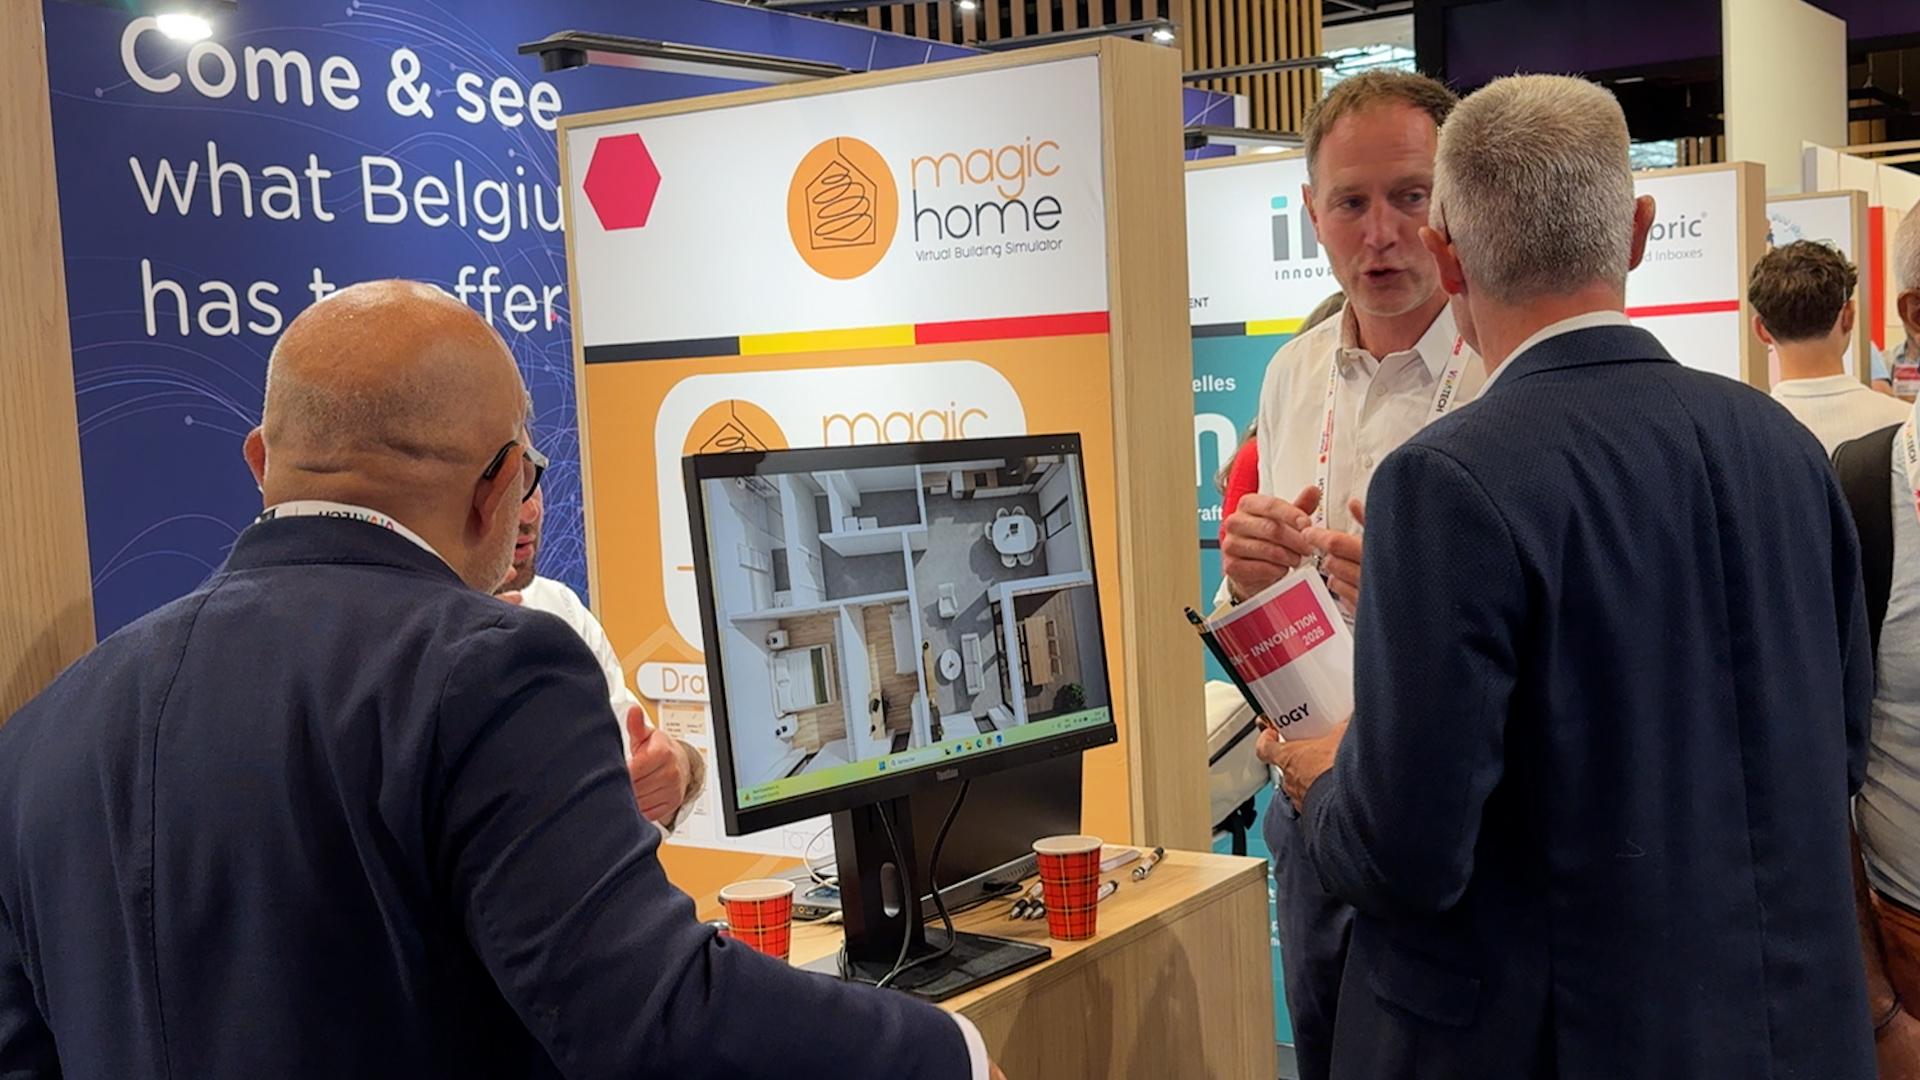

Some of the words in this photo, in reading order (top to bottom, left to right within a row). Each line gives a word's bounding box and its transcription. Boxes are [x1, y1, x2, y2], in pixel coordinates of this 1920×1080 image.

[120, 16, 361, 110] Come
[386, 48, 433, 119] &
[455, 71, 562, 131] see
[129, 141, 335, 222] what
[911, 136, 1061, 200] magic
[913, 189, 1062, 241] home
[916, 248, 951, 261] Virtual
[955, 243, 1002, 258] Building
[1005, 238, 1063, 255] Simulator
[1655, 248, 1703, 262] Inboxes
[141, 258, 283, 336] has
[430, 265, 563, 333] ffer
[1250, 611, 1318, 657] INNOVATION
[662, 667, 705, 695] Dra
